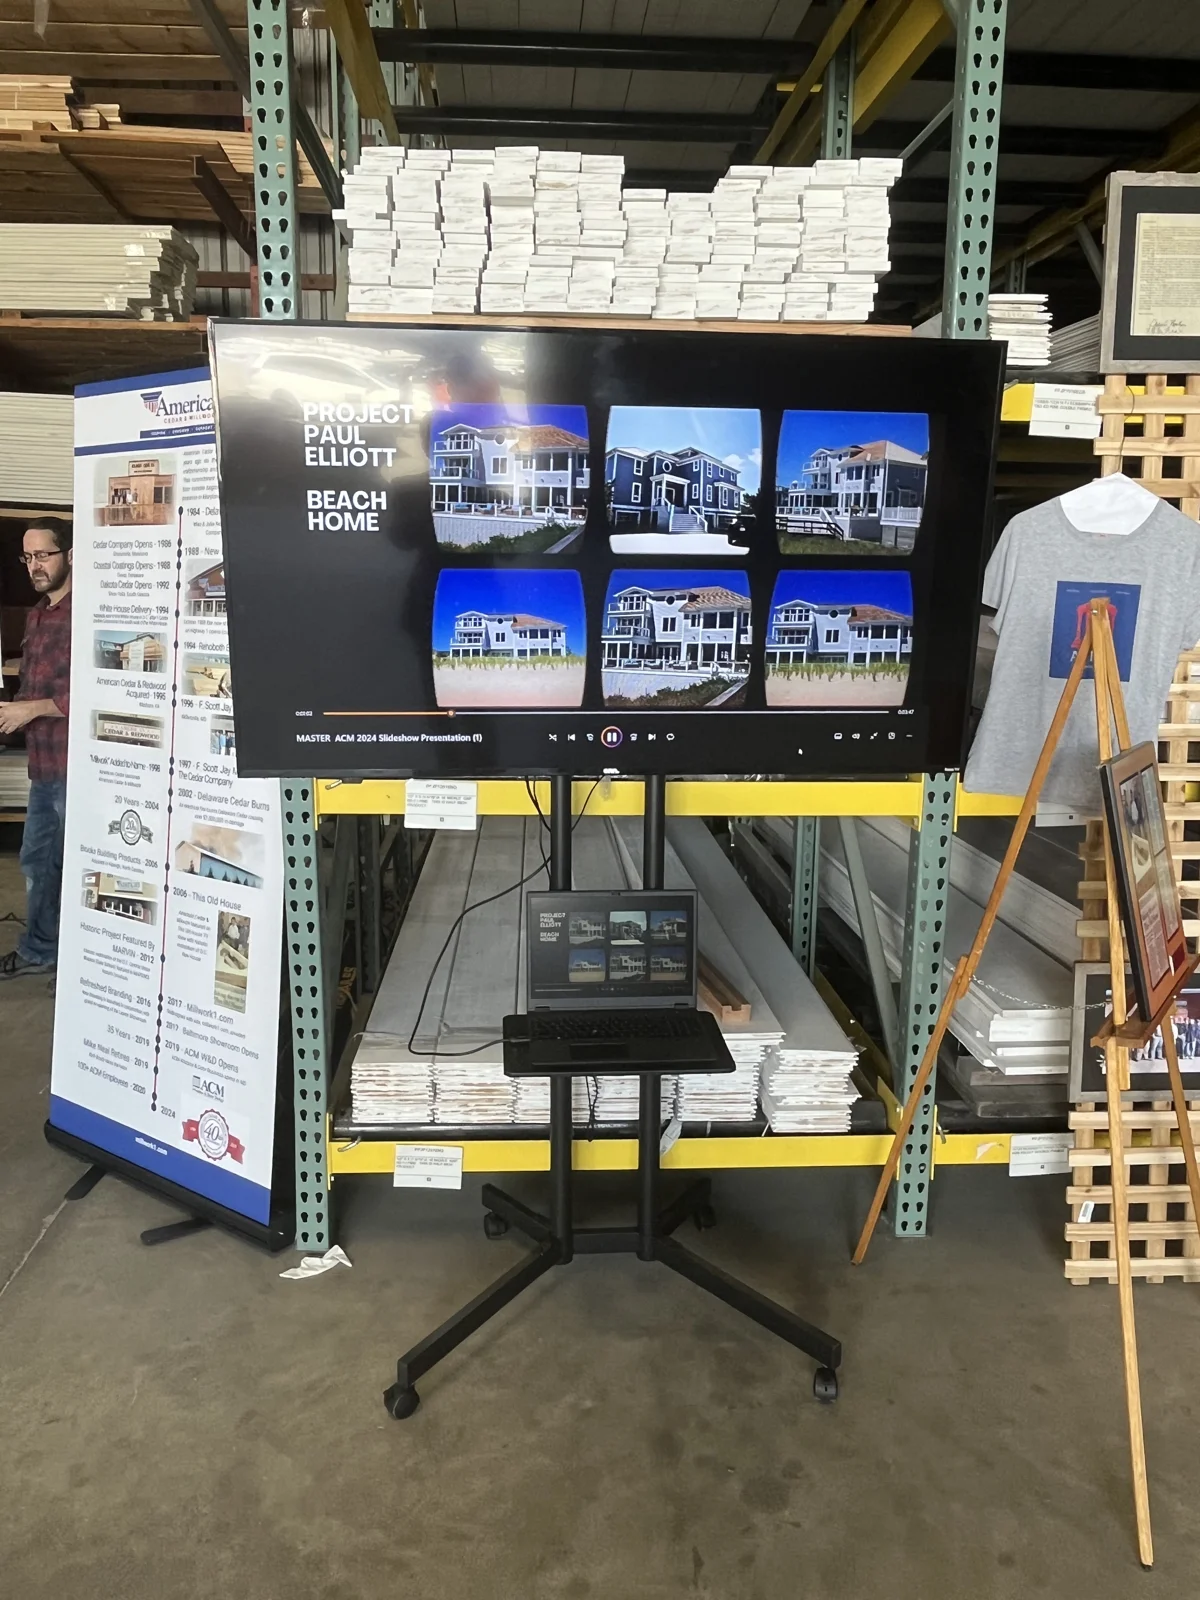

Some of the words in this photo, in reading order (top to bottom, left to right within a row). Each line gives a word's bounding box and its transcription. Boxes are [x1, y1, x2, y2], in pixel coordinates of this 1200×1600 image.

[302, 402, 414, 424] PROJECT
[304, 424, 366, 445] PAUL
[305, 446, 397, 467] ELLIOTT
[306, 490, 388, 510] BEACH
[308, 512, 380, 532] HOME
[108, 540, 133, 550] Company
[134, 540, 153, 550] Opens
[204, 548, 220, 556] New
[135, 560, 153, 570] Opens
[134, 580, 153, 590] Opens
[156, 581, 170, 590] 1992
[113, 605, 130, 613] House
[131, 605, 152, 615] Delivery
[156, 606, 169, 614] 1994
[96, 677, 120, 686] American
[120, 678, 136, 688] Cedar
[142, 680, 167, 691] Redwood
[126, 689, 150, 699] Acquired
[204, 702, 220, 711] Scott
[221, 704, 232, 714] Jay
[104, 728, 124, 736] CEDAR
[296, 734, 331, 743] MASTER
[334, 734, 354, 742] ACM
[356, 734, 377, 742] 2024
[378, 734, 420, 742] Slideshow
[421, 734, 472, 742] Presentation
[472, 734, 482, 743] (1)
[203, 762, 218, 773] Scott
[220, 765, 231, 776] Jay
[204, 774, 234, 788] Company
[124, 796, 140, 807] Years
[197, 791, 229, 804] Delaware
[230, 796, 250, 807] Cedar
[251, 800, 270, 812] Burns
[192, 891, 206, 902] This
[207, 895, 219, 906] Old
[220, 898, 242, 911] House
[80, 922, 101, 935] Historic
[102, 928, 122, 940] Project
[122, 933, 147, 948] Featured
[148, 940, 156, 952] By
[112, 944, 136, 958] MARVIN
[139, 952, 155, 964] 2012
[136, 996, 151, 1007] 2016
[167, 996, 182, 1008] 2017
[187, 1003, 234, 1025] Millwork1.com
[107, 1024, 114, 1034] 35
[115, 1028, 131, 1040] Years
[135, 1034, 150, 1046] 2019
[182, 1027, 209, 1043] Baltimore
[209, 1035, 241, 1053] Showroom
[241, 1047, 260, 1060] Opens
[134, 1057, 149, 1069] 2019
[164, 1040, 180, 1052] 2019
[184, 1047, 200, 1059] ACM
[200, 1052, 217, 1065] W&D
[218, 1058, 239, 1073] Opens
[90, 1066, 102, 1077] ACM
[200, 1079, 225, 1097] ACM
[160, 1105, 176, 1119] 2024
[204, 1123, 220, 1140] 40
